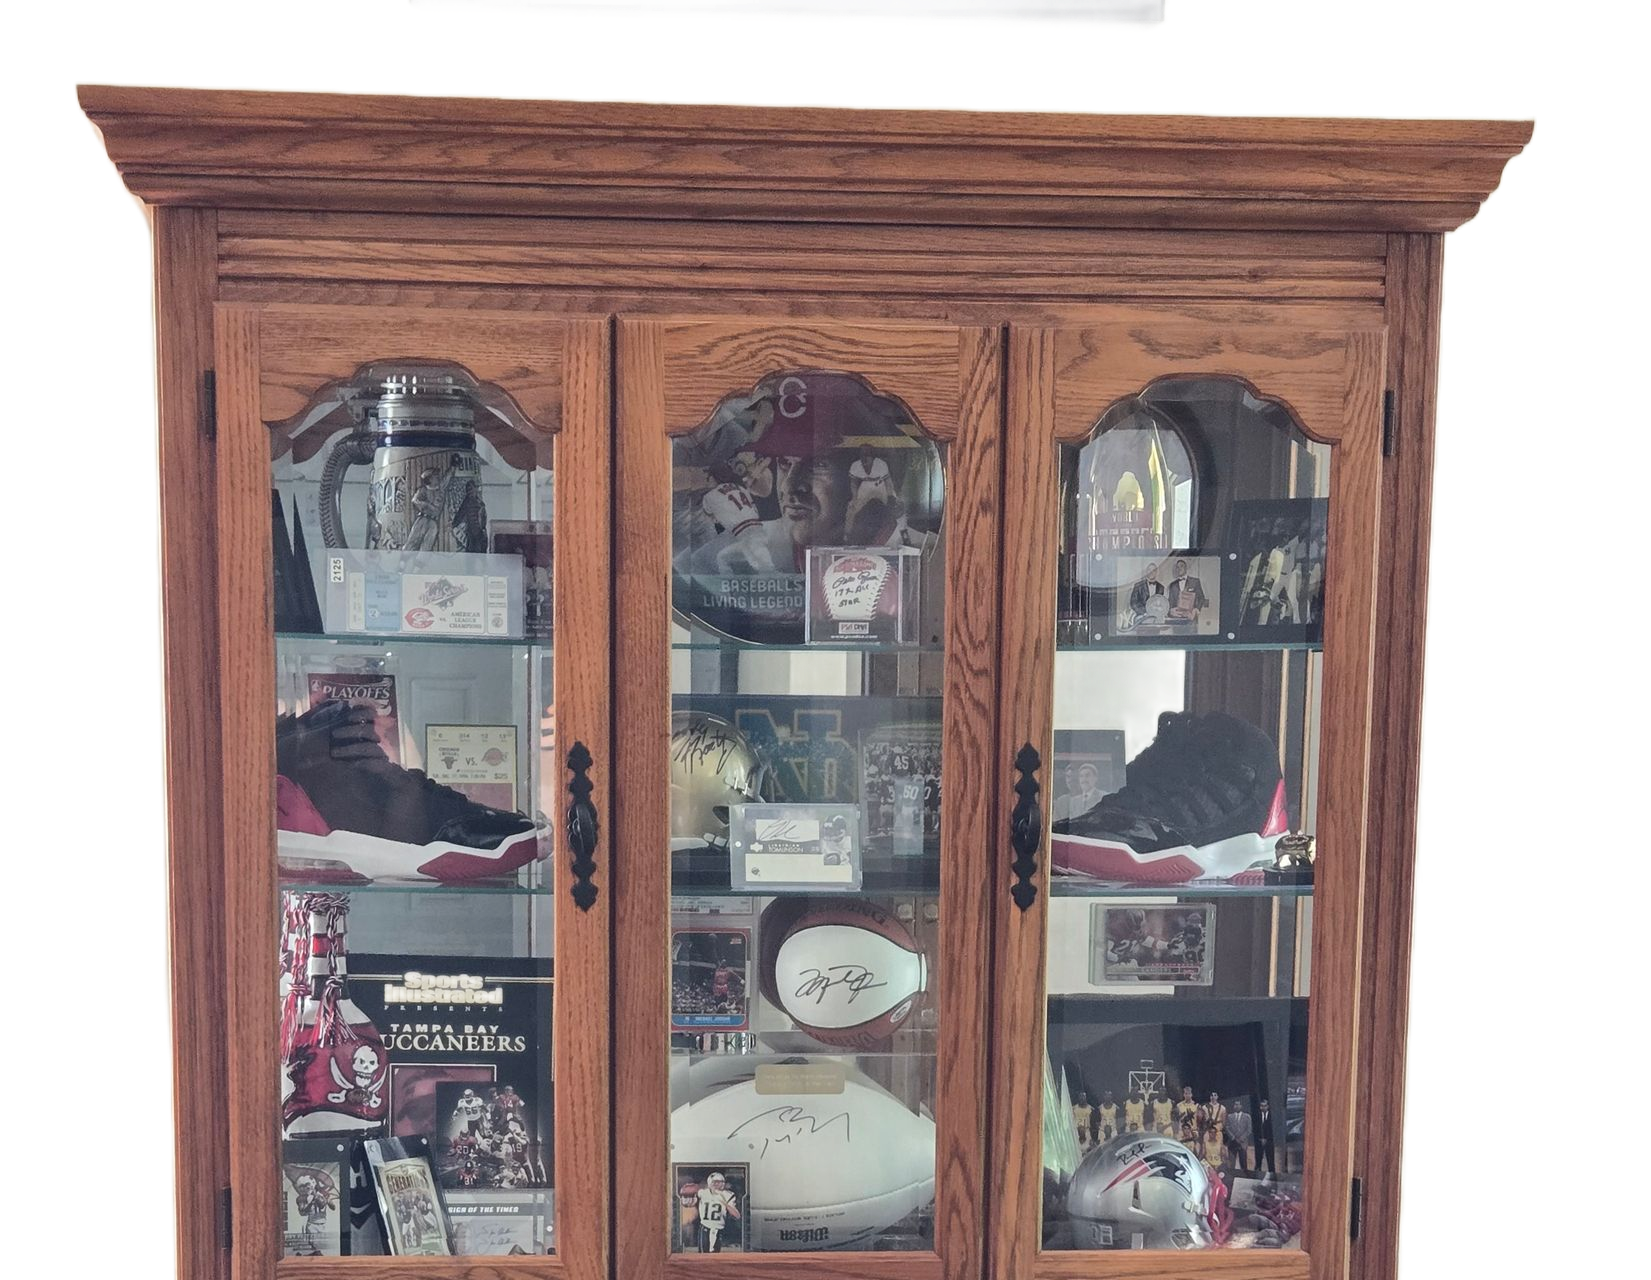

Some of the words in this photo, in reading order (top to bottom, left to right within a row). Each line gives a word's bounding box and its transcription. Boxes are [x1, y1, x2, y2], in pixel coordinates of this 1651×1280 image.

[333, 559, 342, 582] 2125
[323, 685, 390, 699] PLAYOFFS
[404, 971, 484, 990] Sports
[384, 984, 503, 1004] Illustrated
[390, 1023, 454, 1033] TAMPA
[464, 1025, 500, 1034] BAY
[380, 1034, 527, 1052] UCCANEERS
[703, 1202, 722, 1221] 12
